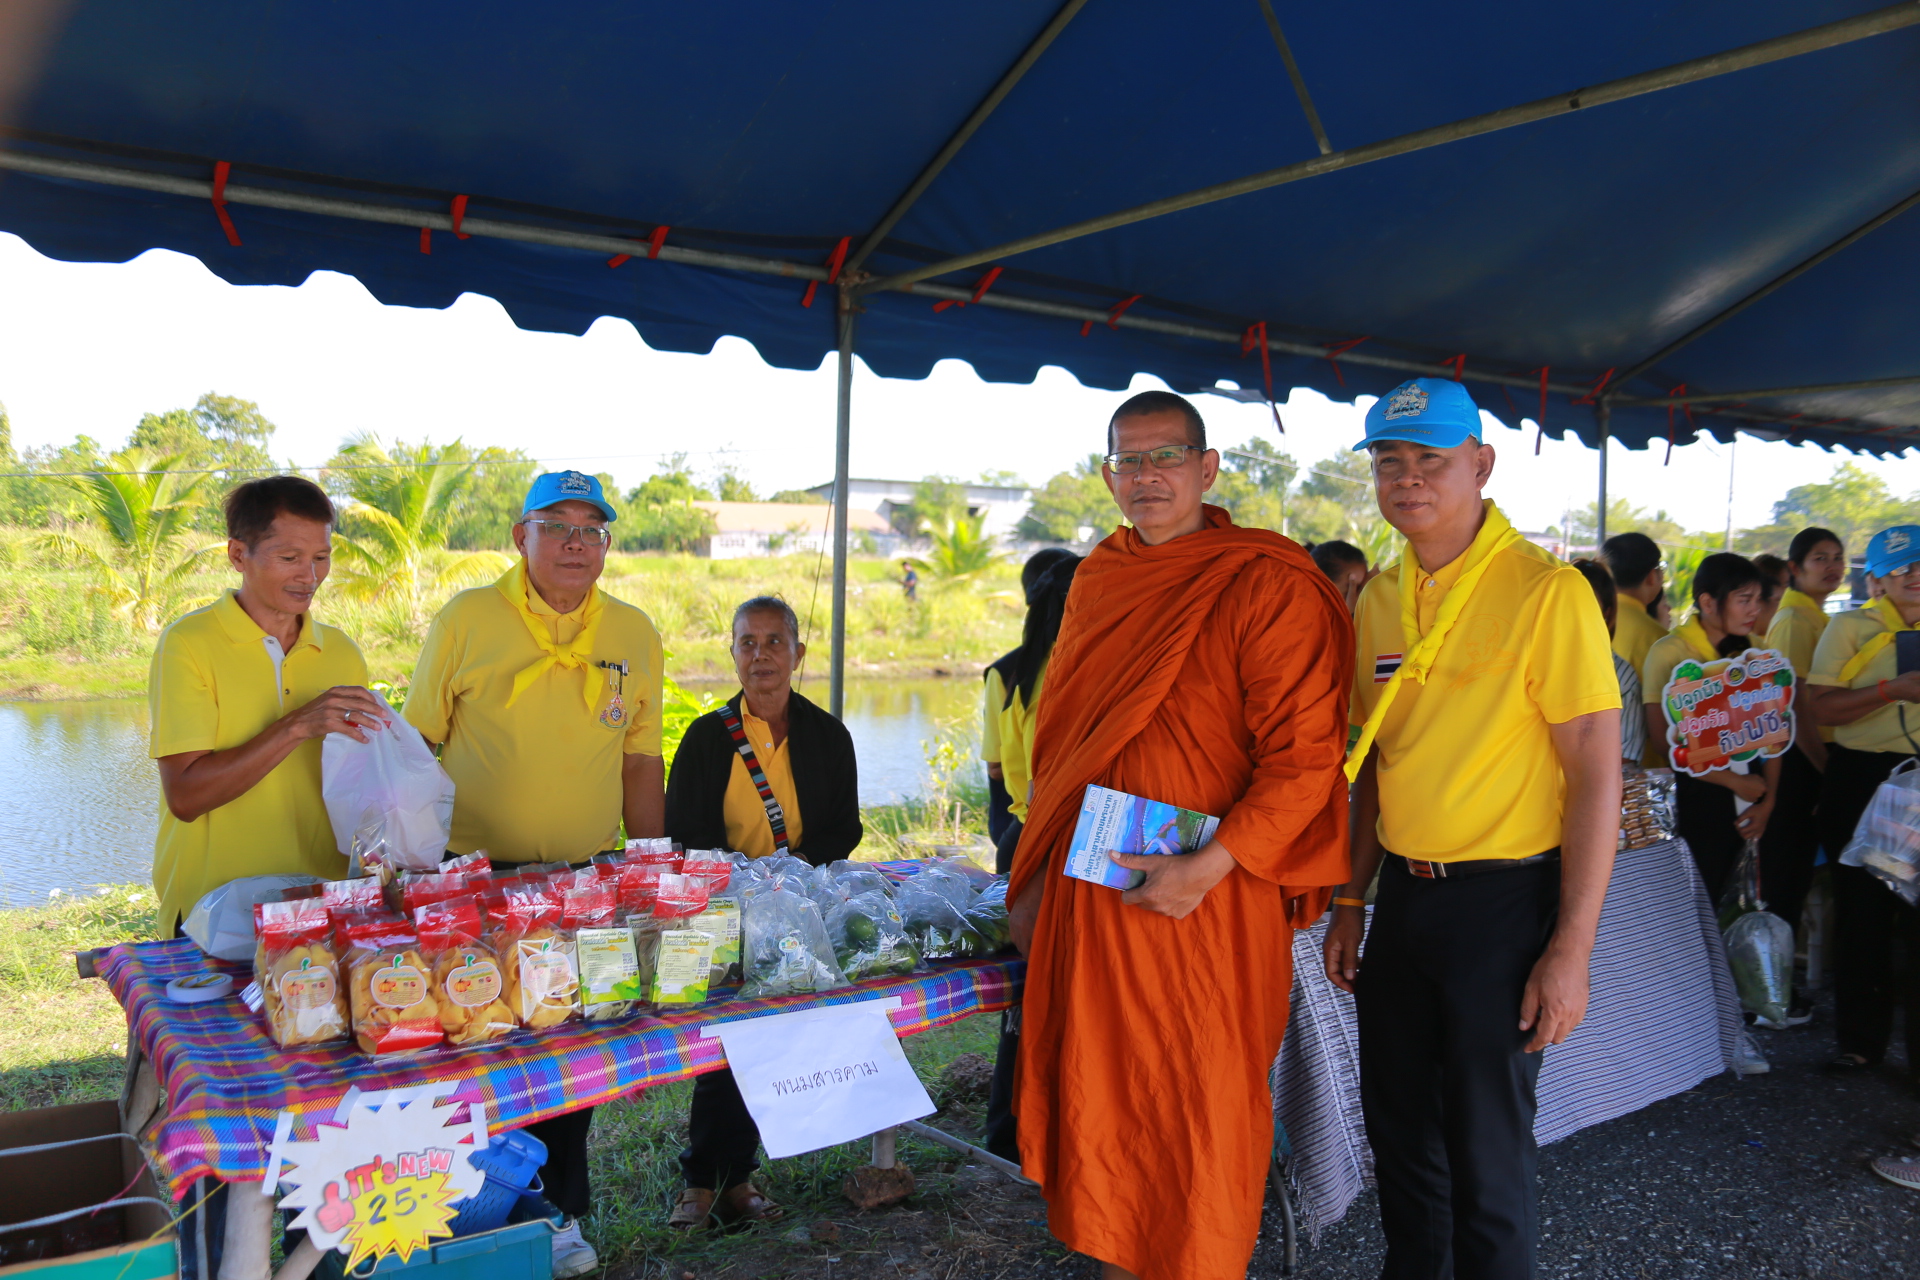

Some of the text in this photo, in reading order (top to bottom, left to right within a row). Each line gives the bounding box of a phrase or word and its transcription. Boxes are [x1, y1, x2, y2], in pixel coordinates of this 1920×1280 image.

[1671, 679, 1723, 711] ปลูกพืช
[1728, 683, 1783, 711] ปลูกผัก
[1677, 708, 1729, 736] ปลูกรัก
[772, 1060, 879, 1097] พนมสารคาม
[397, 1146, 455, 1181] NEW
